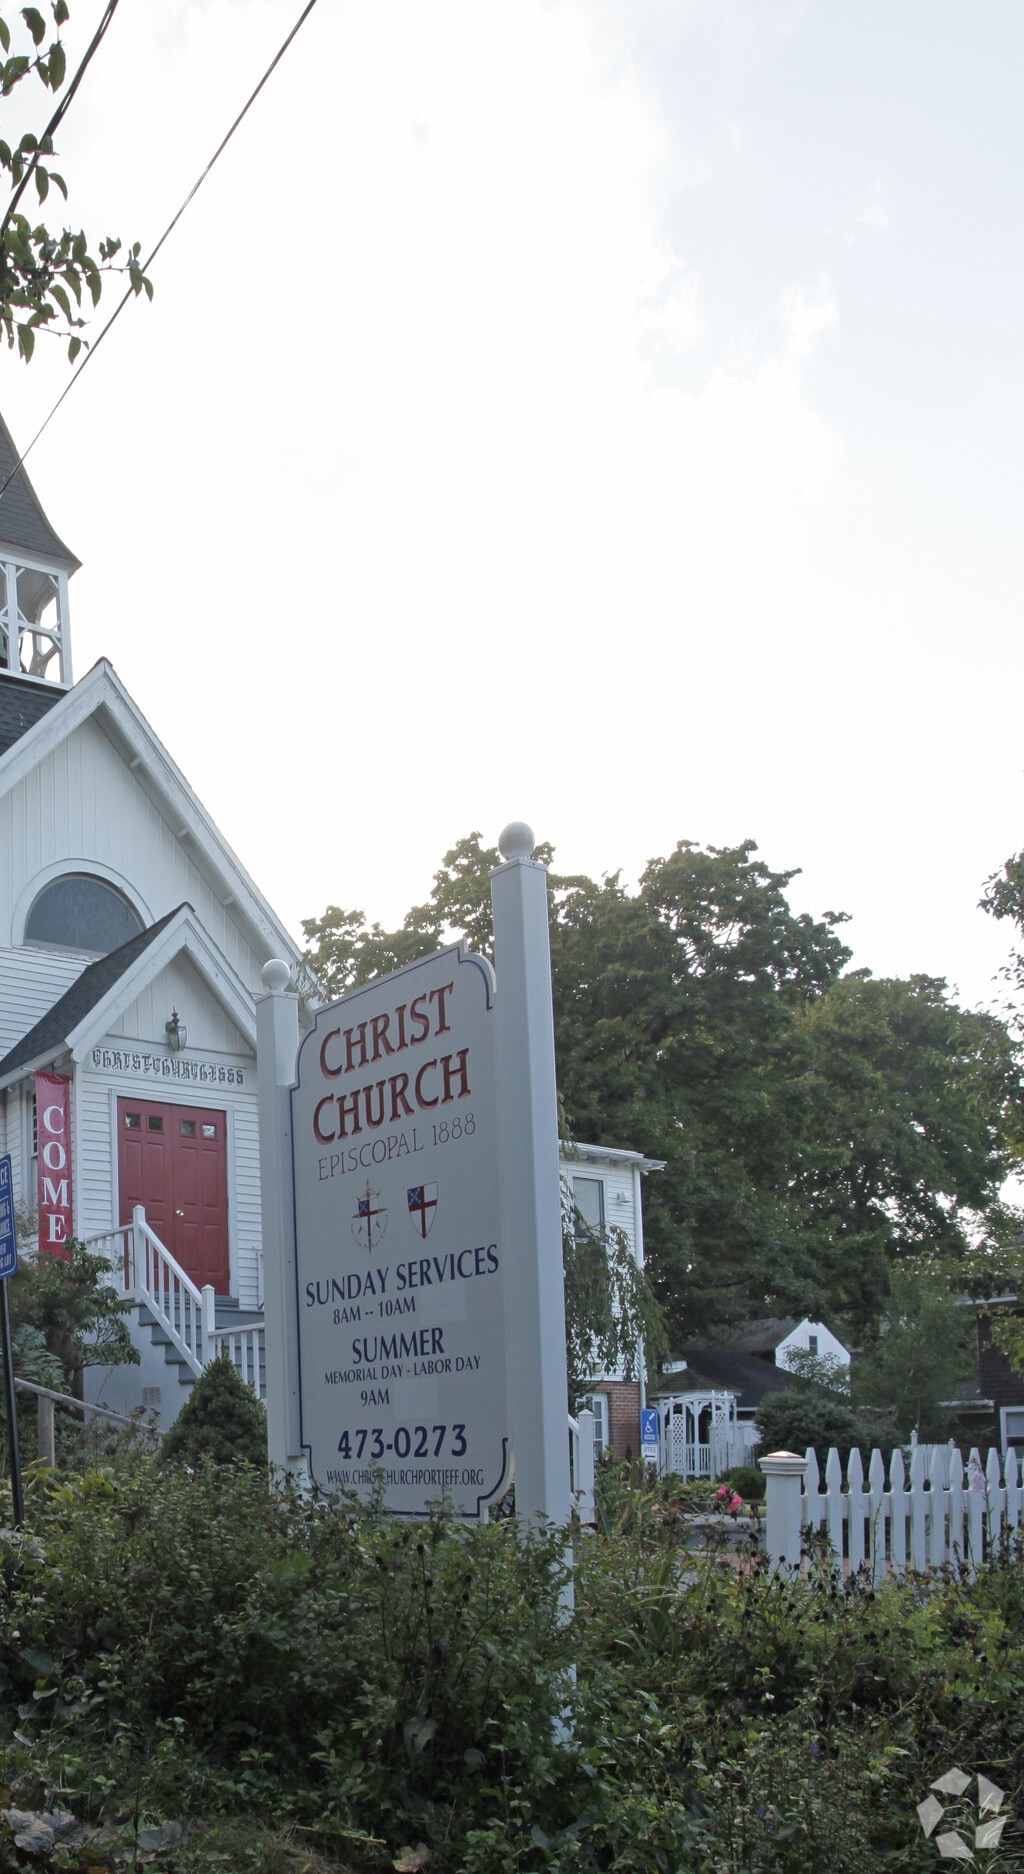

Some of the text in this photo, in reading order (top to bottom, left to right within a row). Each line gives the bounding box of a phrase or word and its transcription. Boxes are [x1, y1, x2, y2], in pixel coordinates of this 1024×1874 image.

[319, 981, 454, 1080] CHRIST
[313, 1047, 472, 1146] CHURCH
[318, 1112, 476, 1181] EPISCOPAL 1888
[41, 1105, 70, 1242] COME
[306, 1244, 500, 1307] SUNDAY SERVICES
[333, 1305, 361, 1325] 8AM
[378, 1295, 416, 1318] 10AM
[352, 1327, 445, 1364] SUMMER
[324, 1367, 378, 1385] MEMORIAL
[381, 1364, 404, 1380] DAY
[414, 1358, 452, 1376] LABOR
[455, 1355, 481, 1372] DAY
[360, 1388, 390, 1407] 9AM
[337, 1424, 467, 1459] 473-0273
[326, 1469, 484, 1486] WWW.CHRISCHURCHPORTJEFF.ORG
